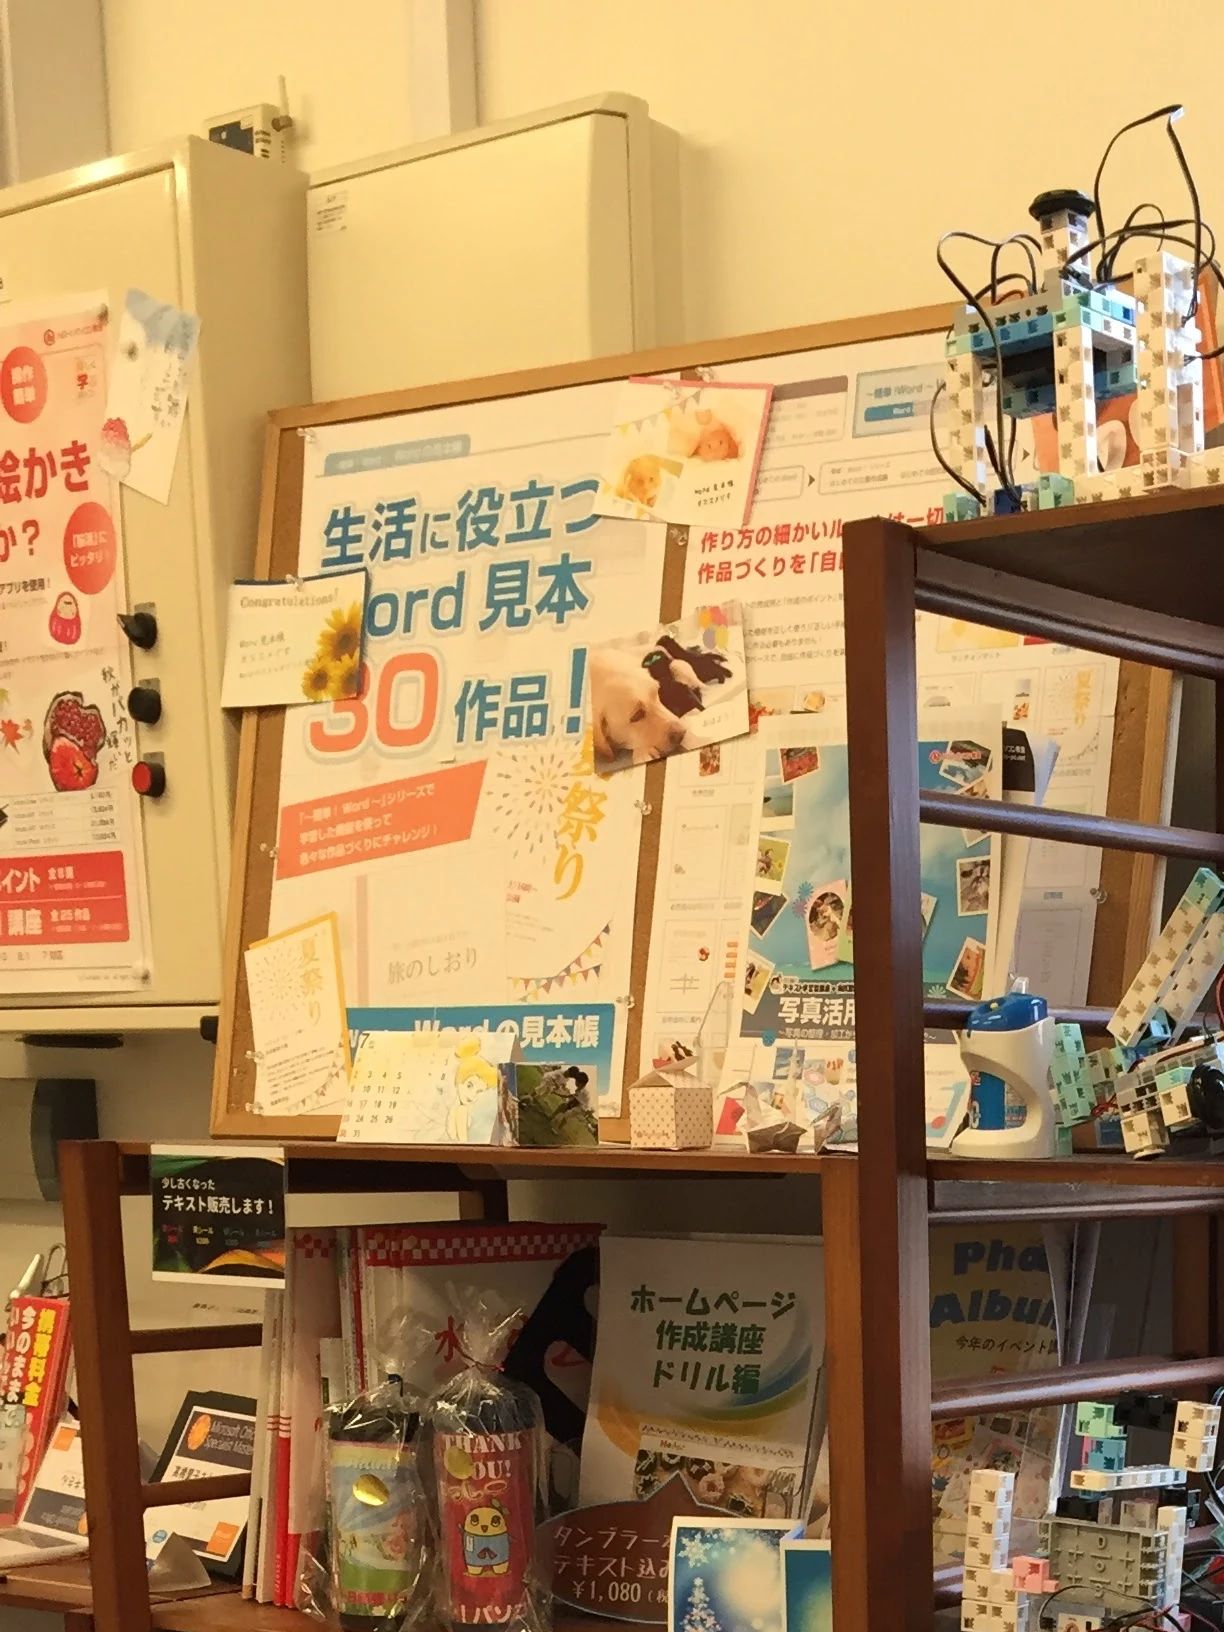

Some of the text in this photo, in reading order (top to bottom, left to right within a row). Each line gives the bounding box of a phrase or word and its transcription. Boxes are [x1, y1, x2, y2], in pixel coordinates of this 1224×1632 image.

[320, 478, 601, 568] 生活に役立つ
[697, 551, 844, 584] 作品づくりを「自
[368, 553, 593, 637] ord 見本
[309, 651, 439, 754] 30
[454, 648, 589, 743] 作品！
[388, 947, 477, 985] 旅のしおり
[161, 1177, 216, 1191] 少し古くなった
[162, 1195, 274, 1215] テキスト販売します！
[630, 1284, 798, 1319] ホームページ
[655, 1319, 767, 1356] 作成講座
[653, 1359, 761, 1395] ドリル編
[442, 1431, 522, 1454] THANK
[471, 1459, 512, 1482] OU!
[553, 1525, 671, 1551] タンブラー
